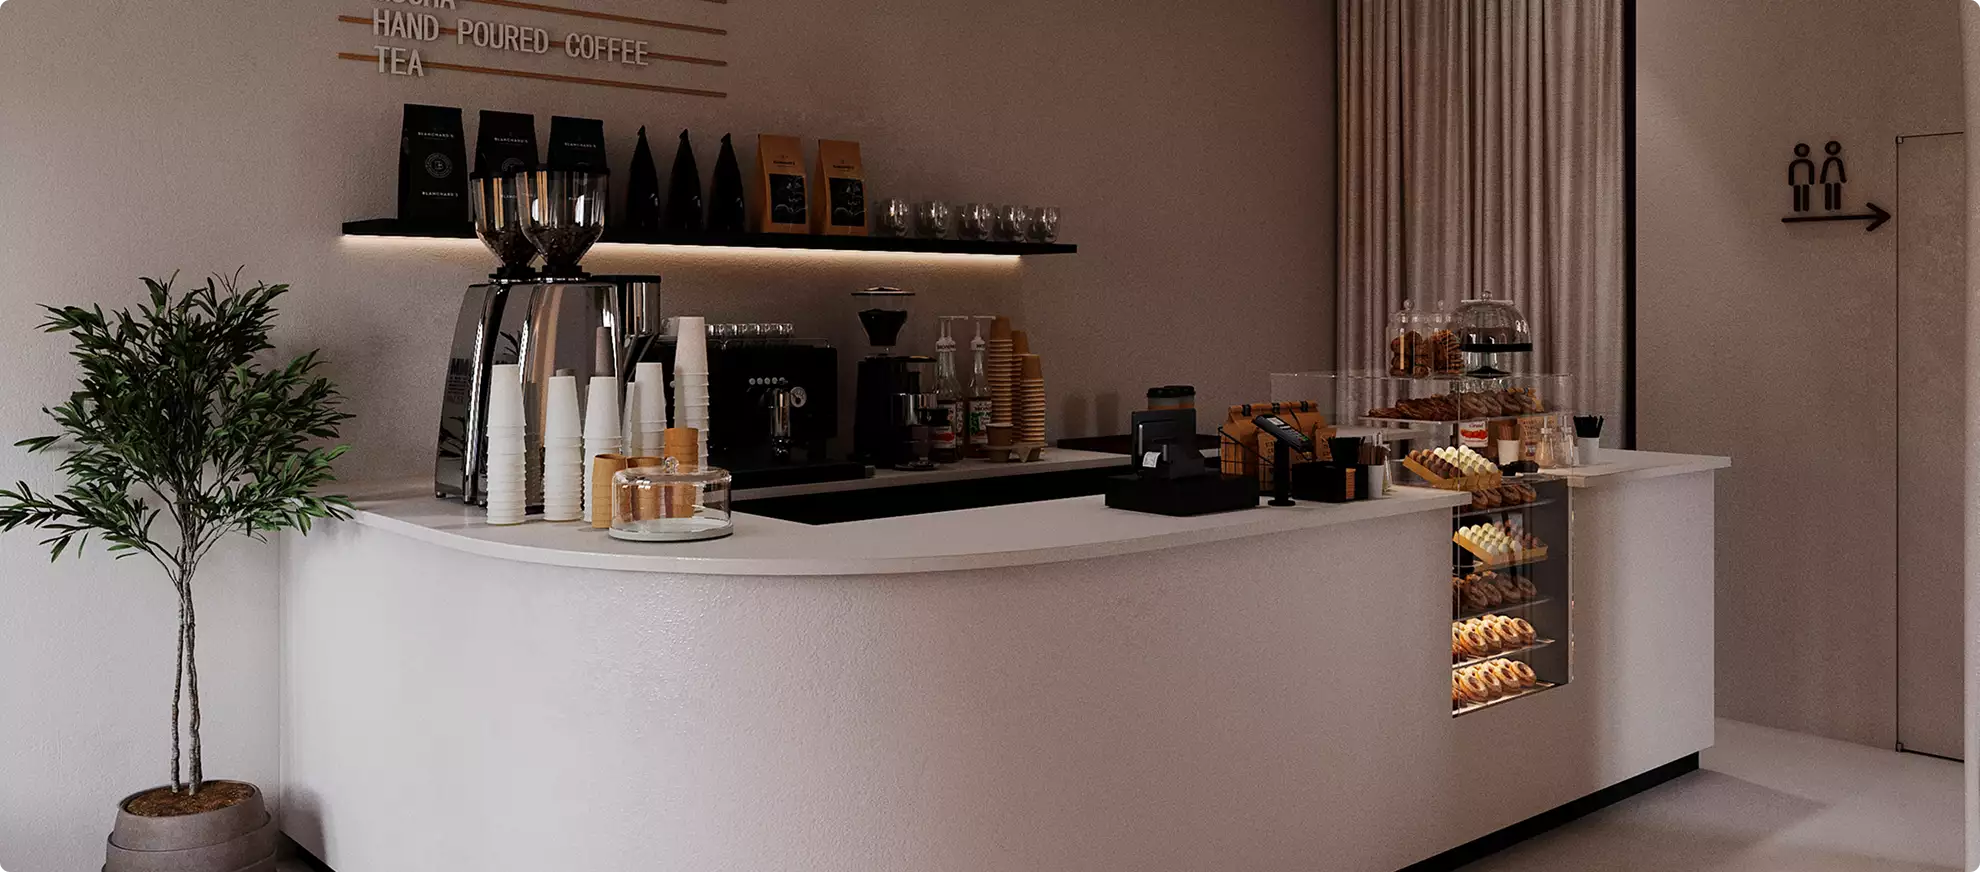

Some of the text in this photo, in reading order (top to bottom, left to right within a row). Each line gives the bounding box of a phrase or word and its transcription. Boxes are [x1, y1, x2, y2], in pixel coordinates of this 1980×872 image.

[373, 8, 649, 66] HAND POURED COFFEE
[374, 45, 424, 77] TEA
